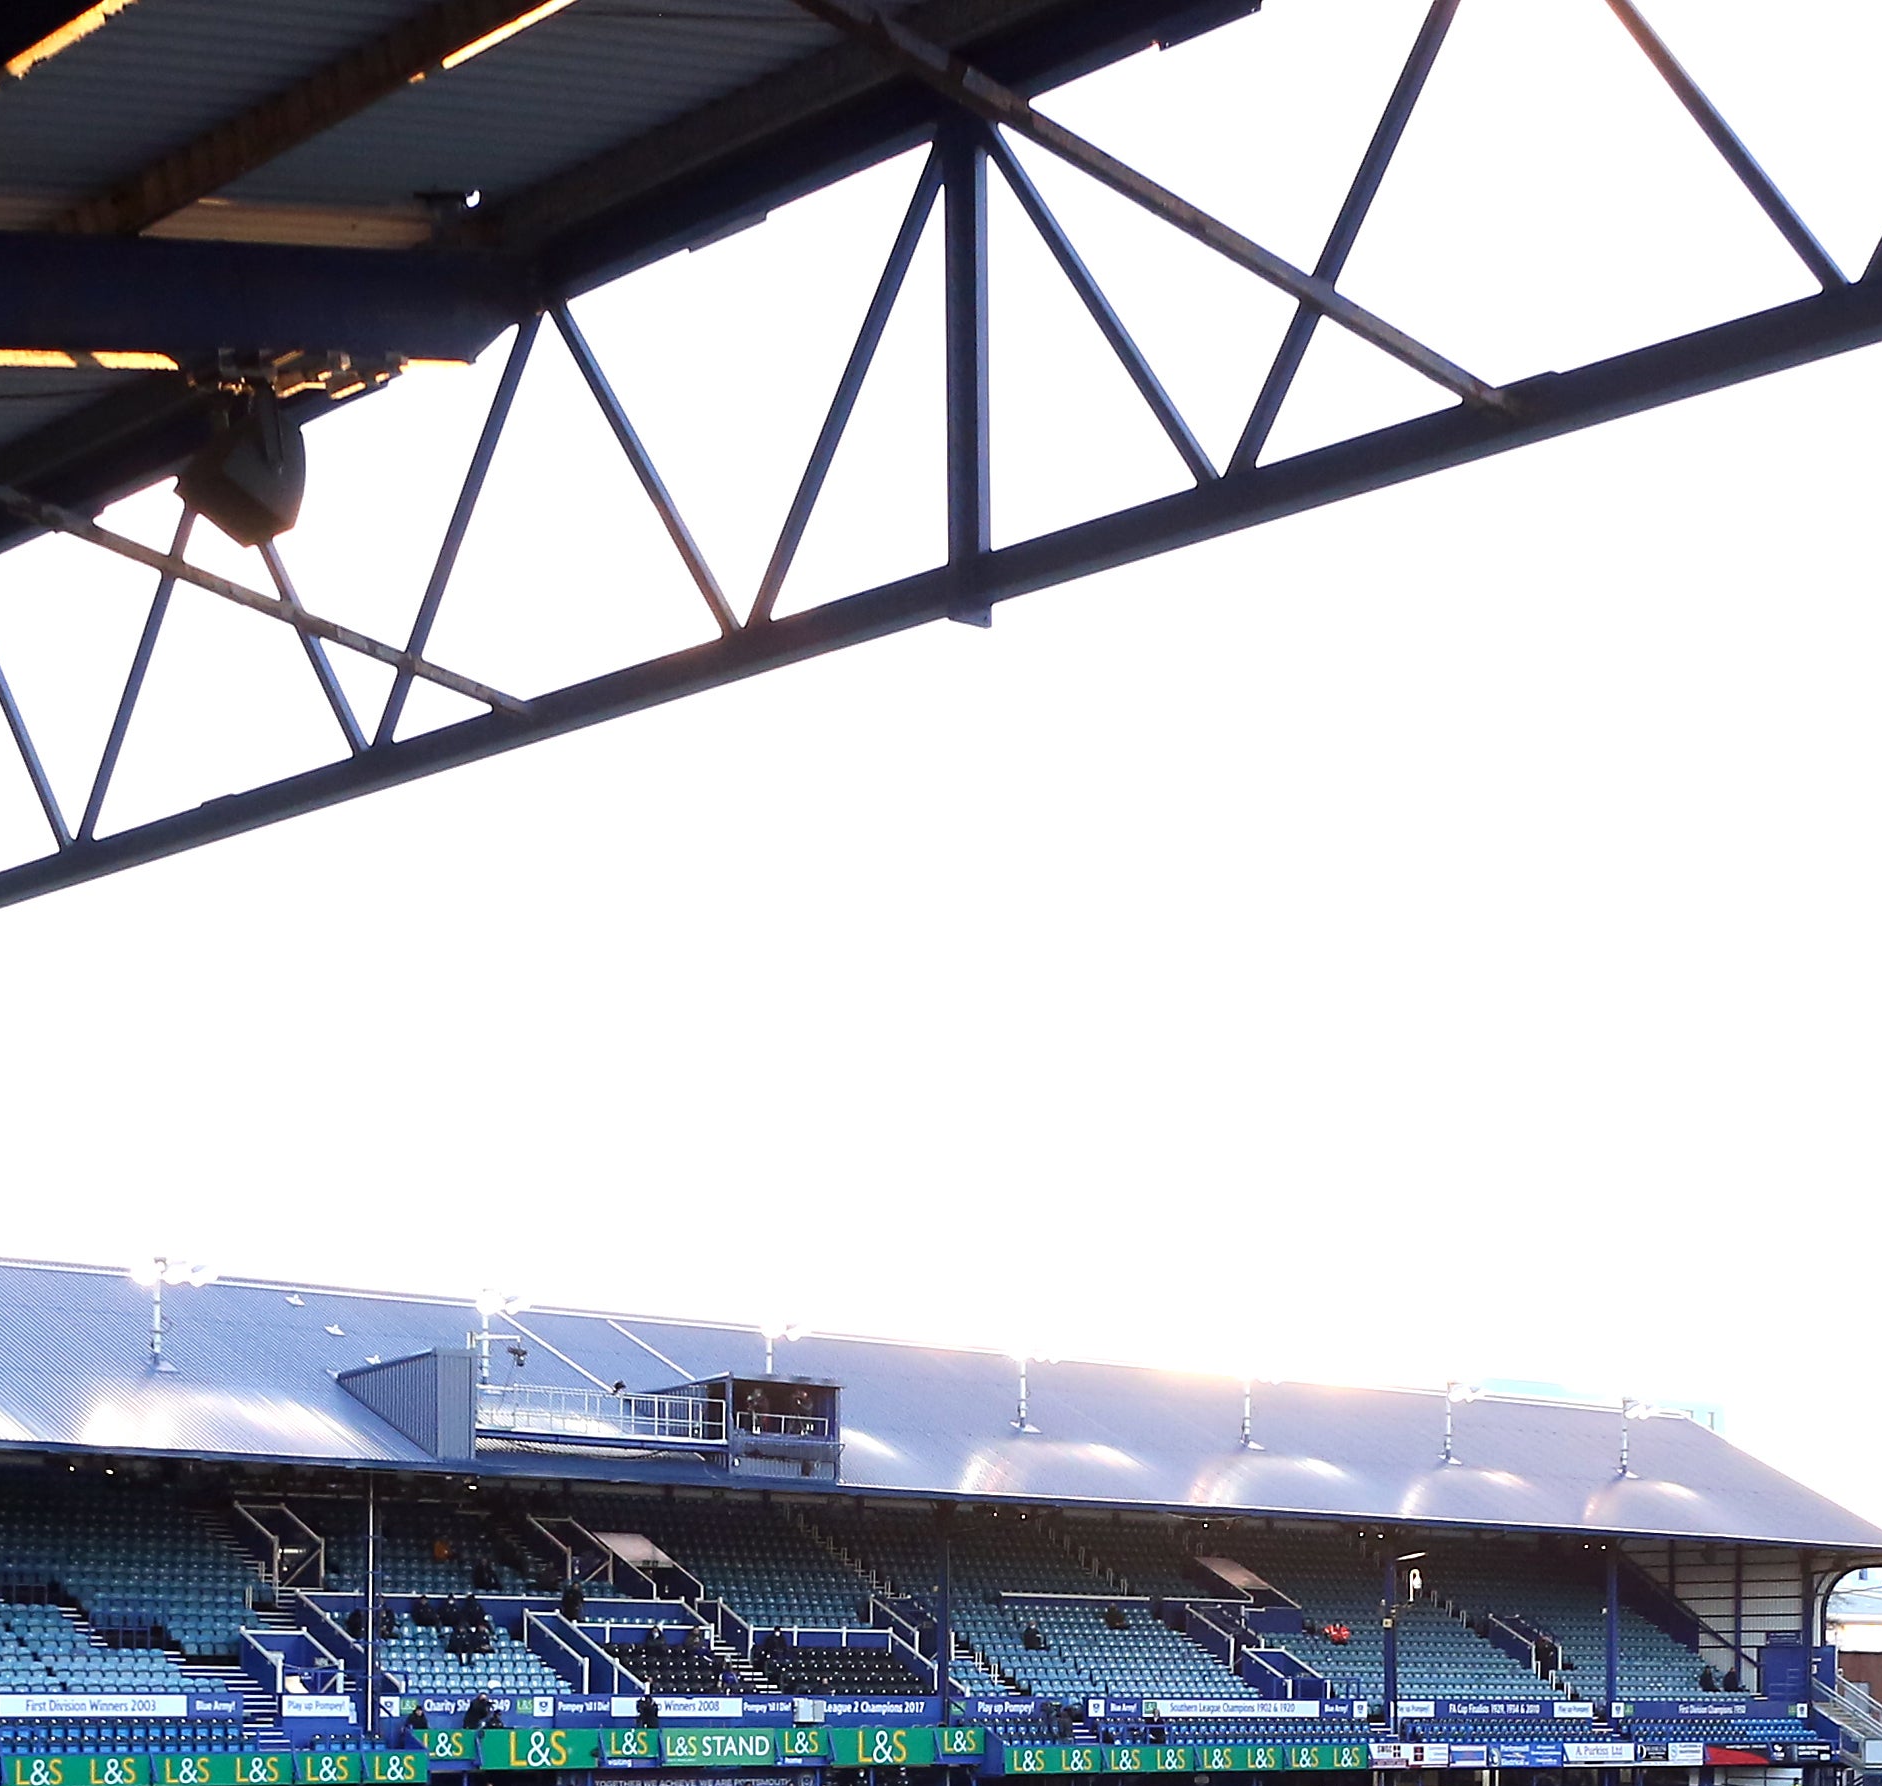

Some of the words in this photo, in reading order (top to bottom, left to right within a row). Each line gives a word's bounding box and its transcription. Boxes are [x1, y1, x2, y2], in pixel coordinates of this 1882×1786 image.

[26, 1701, 46, 1711] First
[49, 1700, 86, 1711] Division
[90, 1701, 129, 1711] Winners
[131, 1700, 156, 1711] 2003
[196, 1700, 212, 1711] Blue
[213, 1700, 236, 1713] Army!
[424, 1700, 455, 1714] Charity
[665, 1701, 696, 1711] Winners
[698, 1701, 719, 1711] 2008
[824, 1701, 851, 1714] League
[861, 1701, 902, 1714] Champions
[905, 1702, 924, 1713] 2017
[978, 1701, 993, 1714] Play
[1005, 1701, 1035, 1714] Pompey!
[1170, 1702, 1197, 1713] Southern
[1198, 1702, 1220, 1714] League
[1223, 1702, 1255, 1714] Champions
[423, 1731, 463, 1757] L&S
[510, 1730, 567, 1767] L&S
[611, 1731, 648, 1756] L&S
[667, 1736, 697, 1758] L&S
[702, 1735, 770, 1757] STAND
[785, 1731, 819, 1754] L&S
[858, 1730, 908, 1764] L&S
[945, 1730, 976, 1753] L&S
[375, 1755, 416, 1781] L&S
[1014, 1750, 1045, 1772] L&S
[1062, 1749, 1092, 1772] L&S
[1111, 1749, 1141, 1771] L&S
[1157, 1748, 1186, 1770] L&S
[1203, 1748, 1232, 1770] L&S
[1247, 1748, 1275, 1769] L&S
[1291, 1747, 1319, 1768] L&S
[1334, 1747, 1360, 1767] L&S
[16, 1758, 63, 1786] L&S
[90, 1758, 136, 1786] L&S
[165, 1757, 210, 1784] L&S
[235, 1757, 280, 1783] L&S
[306, 1756, 349, 1782] L&S
